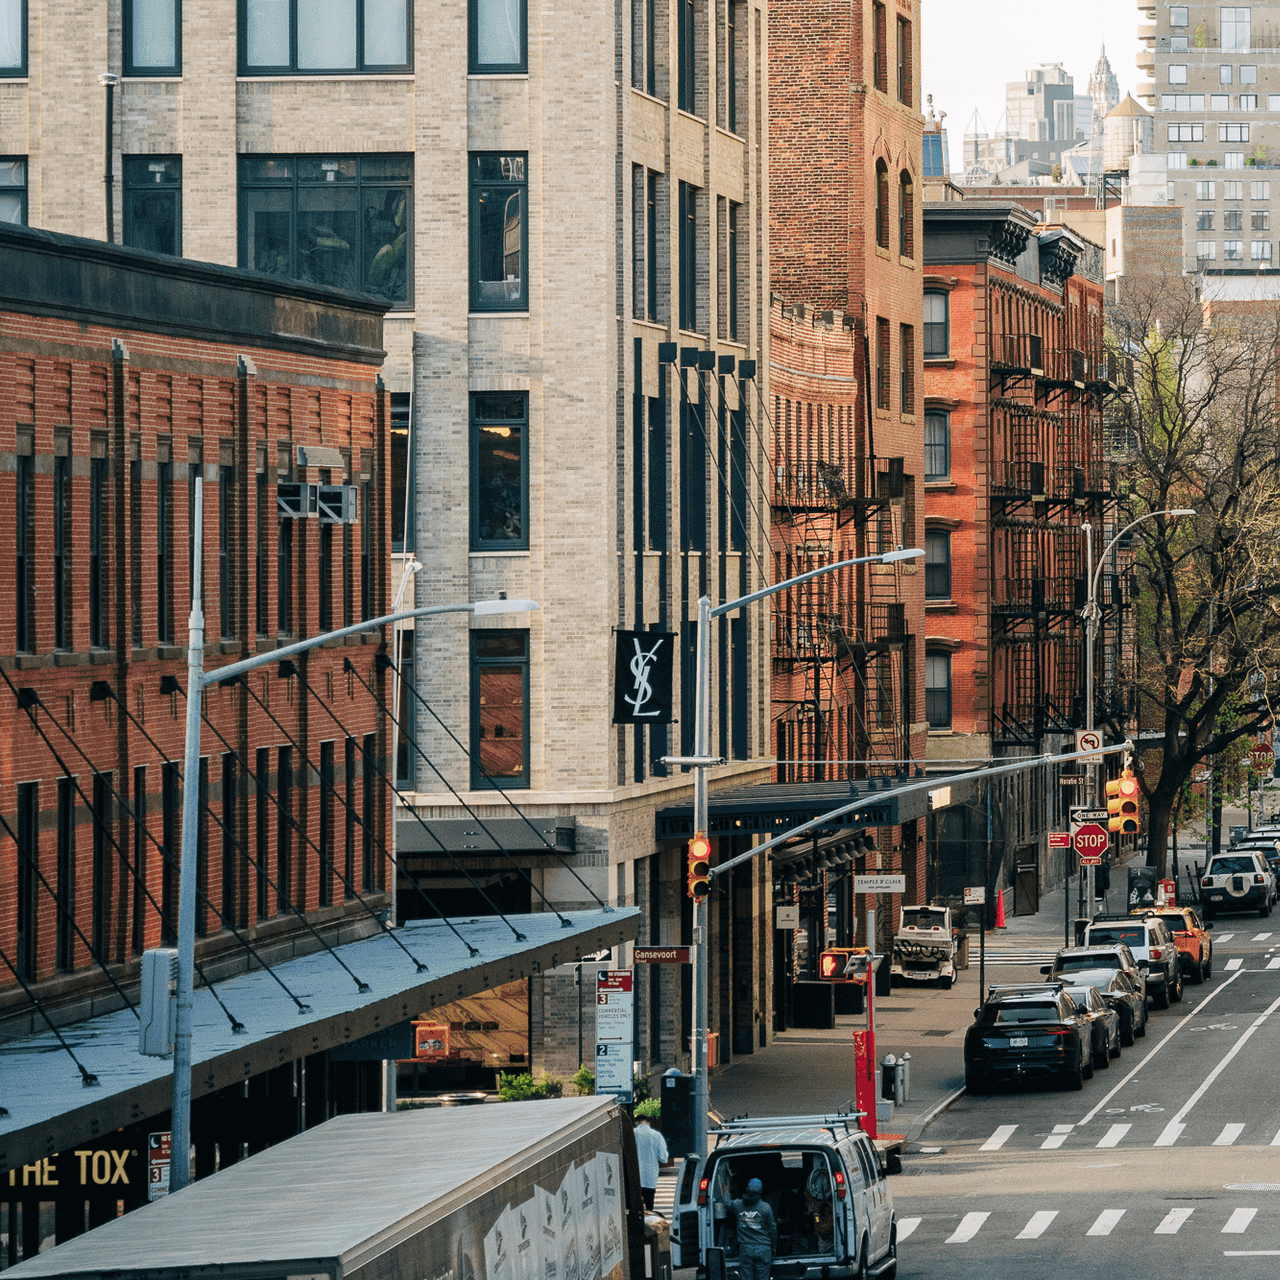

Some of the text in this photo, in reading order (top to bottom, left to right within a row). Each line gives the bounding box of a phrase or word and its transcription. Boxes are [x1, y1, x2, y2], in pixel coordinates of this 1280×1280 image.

[624, 638, 664, 716] YSL
[1077, 835, 1105, 847] STOP
[635, 950, 677, 959] Gansevoort
[600, 995, 607, 1005] 3
[600, 1046, 606, 1055] 2
[75, 1150, 130, 1185] TOX
[153, 1168, 160, 1182] 3
